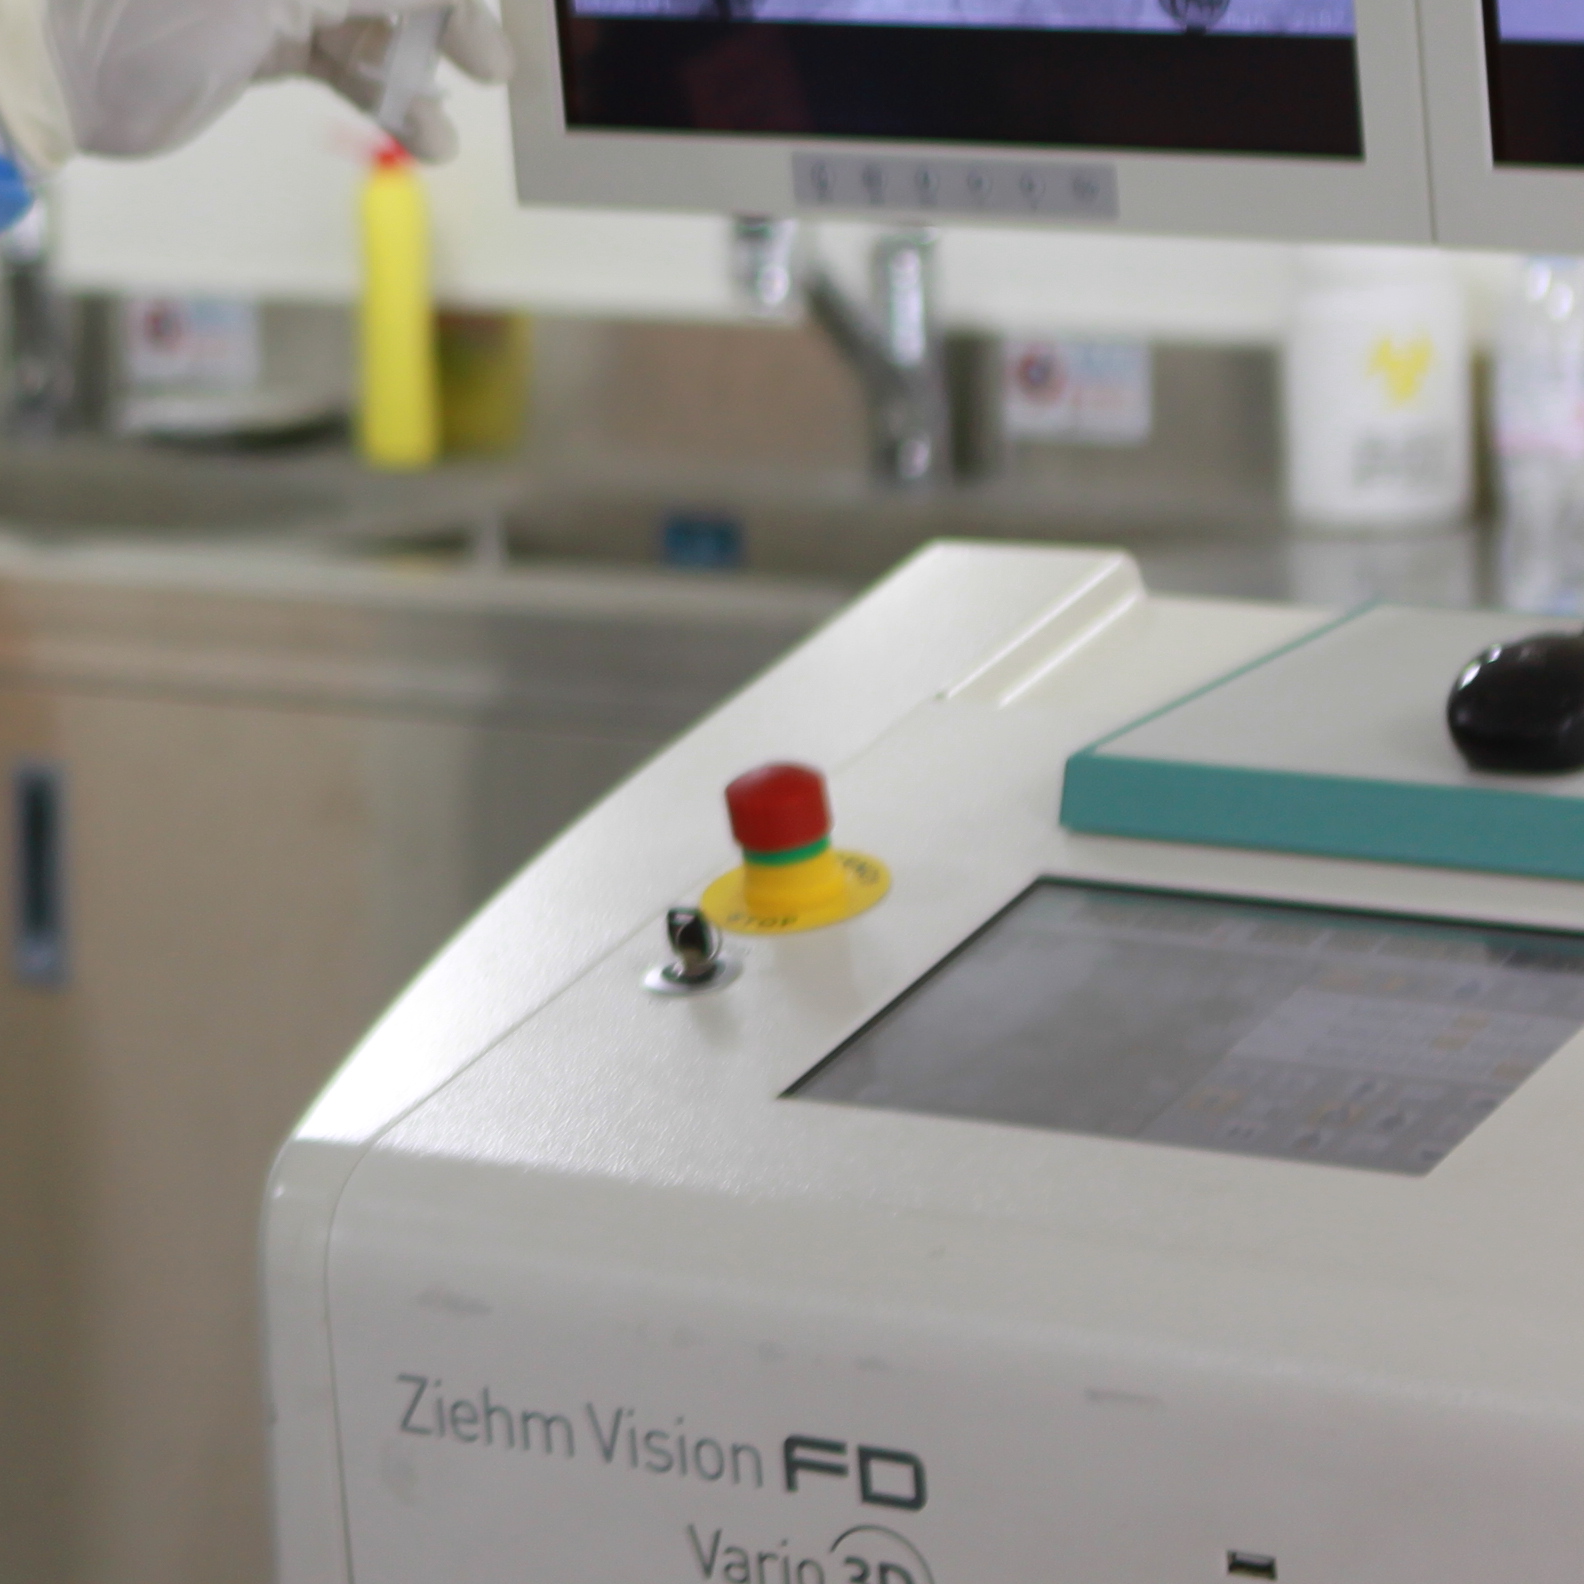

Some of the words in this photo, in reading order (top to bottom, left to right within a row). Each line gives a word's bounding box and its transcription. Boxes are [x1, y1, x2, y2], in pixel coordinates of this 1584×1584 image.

[397, 1373, 576, 1459] Ziehm
[586, 1401, 764, 1489] Vision
[783, 1434, 928, 1512] FD
[686, 1523, 826, 1584] Vario
